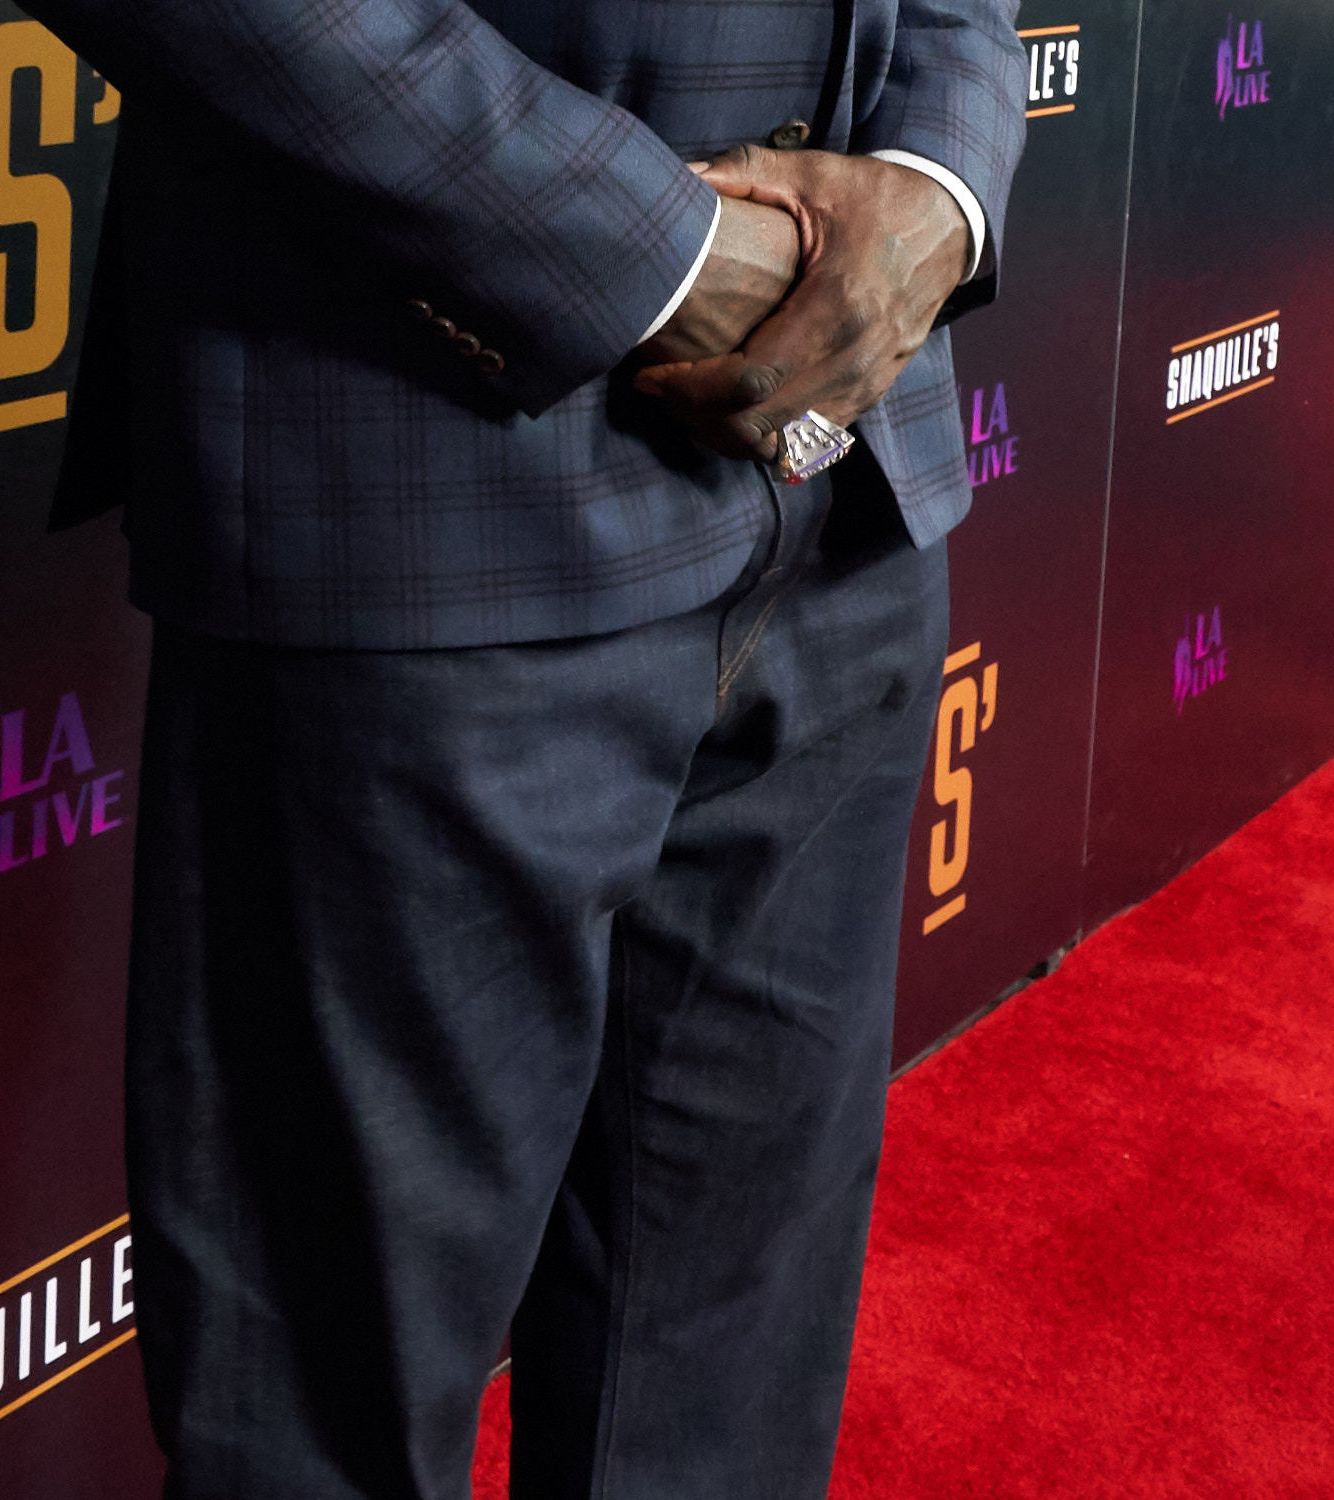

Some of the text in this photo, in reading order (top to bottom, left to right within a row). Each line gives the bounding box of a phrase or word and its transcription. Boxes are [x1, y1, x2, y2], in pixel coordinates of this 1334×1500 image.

[1236, 19, 1265, 70] LA
[1166, 321, 1280, 411] SHAQUILLE'S
[970, 382, 1009, 445] LA
[969, 435, 1020, 488] LIVE
[1194, 604, 1222, 660] LA
